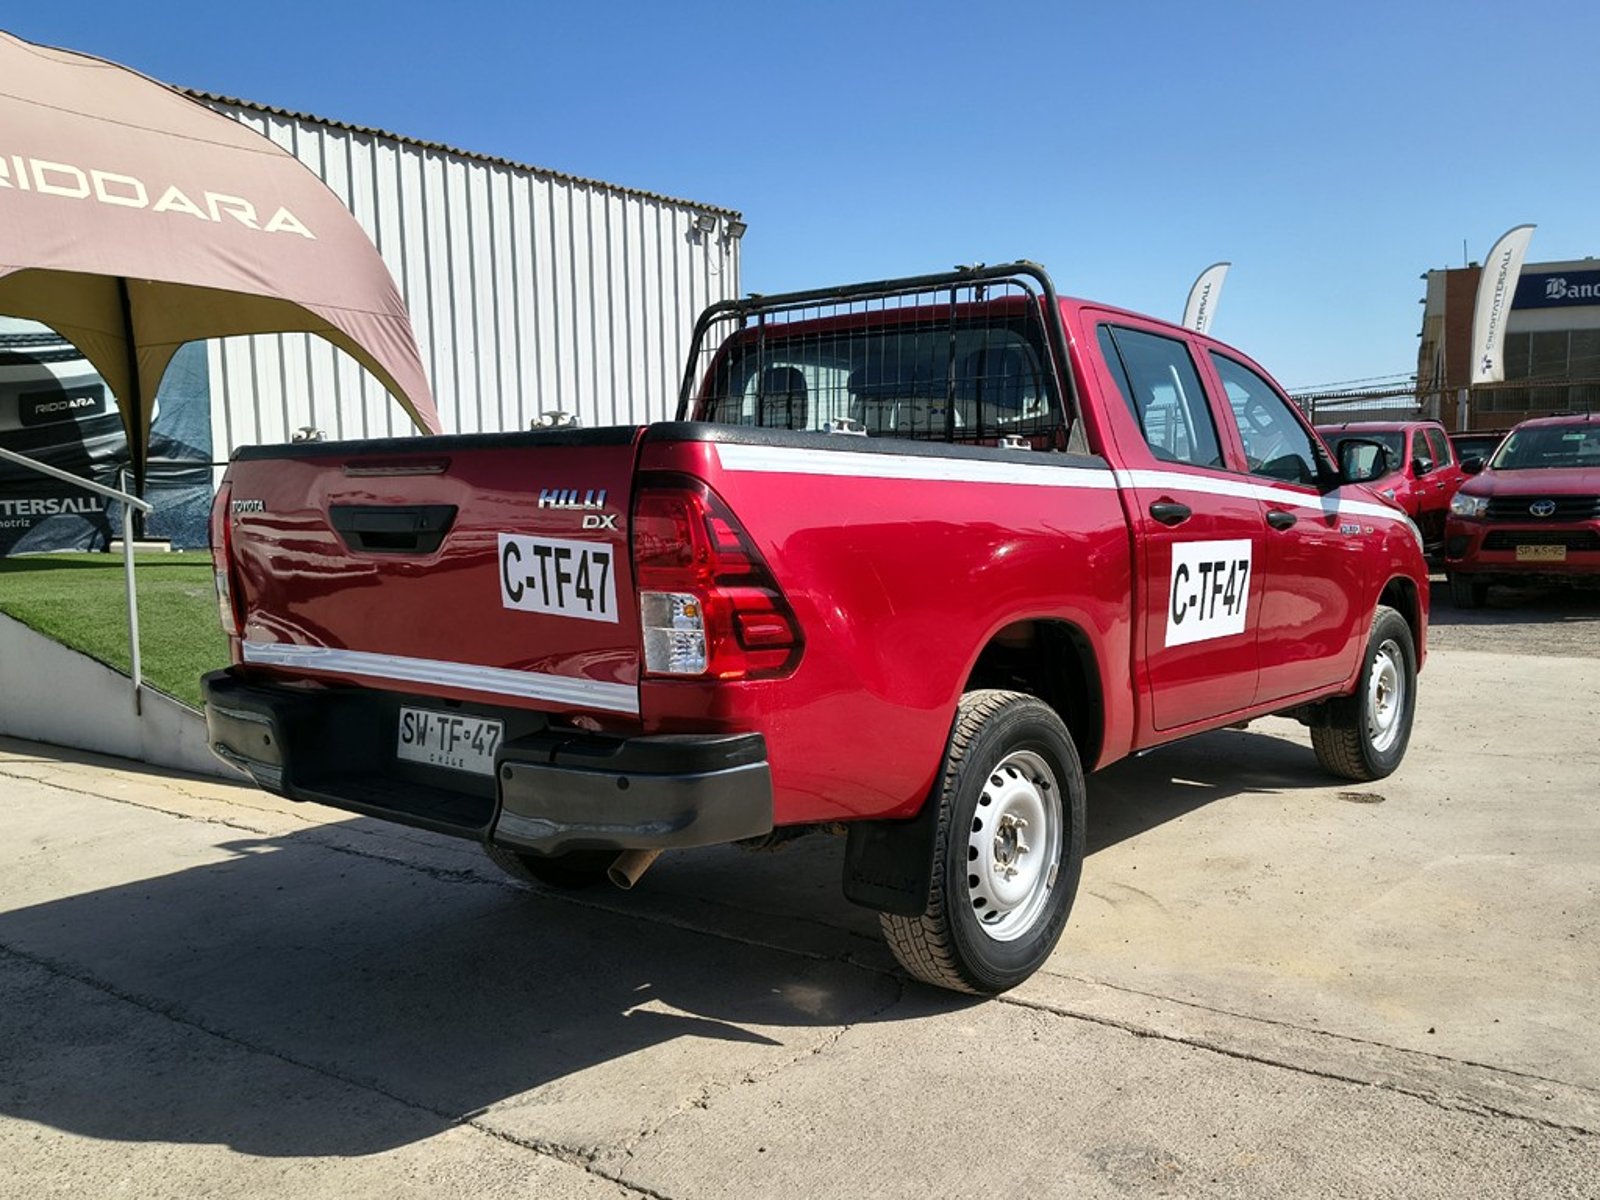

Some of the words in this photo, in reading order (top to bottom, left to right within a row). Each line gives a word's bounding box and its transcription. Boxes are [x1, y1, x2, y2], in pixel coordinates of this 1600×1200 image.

[0, 155, 317, 240] IDDARA
[35, 397, 96, 414] RIDDARA
[0, 498, 104, 516] TERSALL
[232, 500, 263, 512] TOYOTA
[582, 514, 618, 531] DX
[502, 541, 610, 614] C-TF47
[1172, 560, 1249, 626] C-TF47
